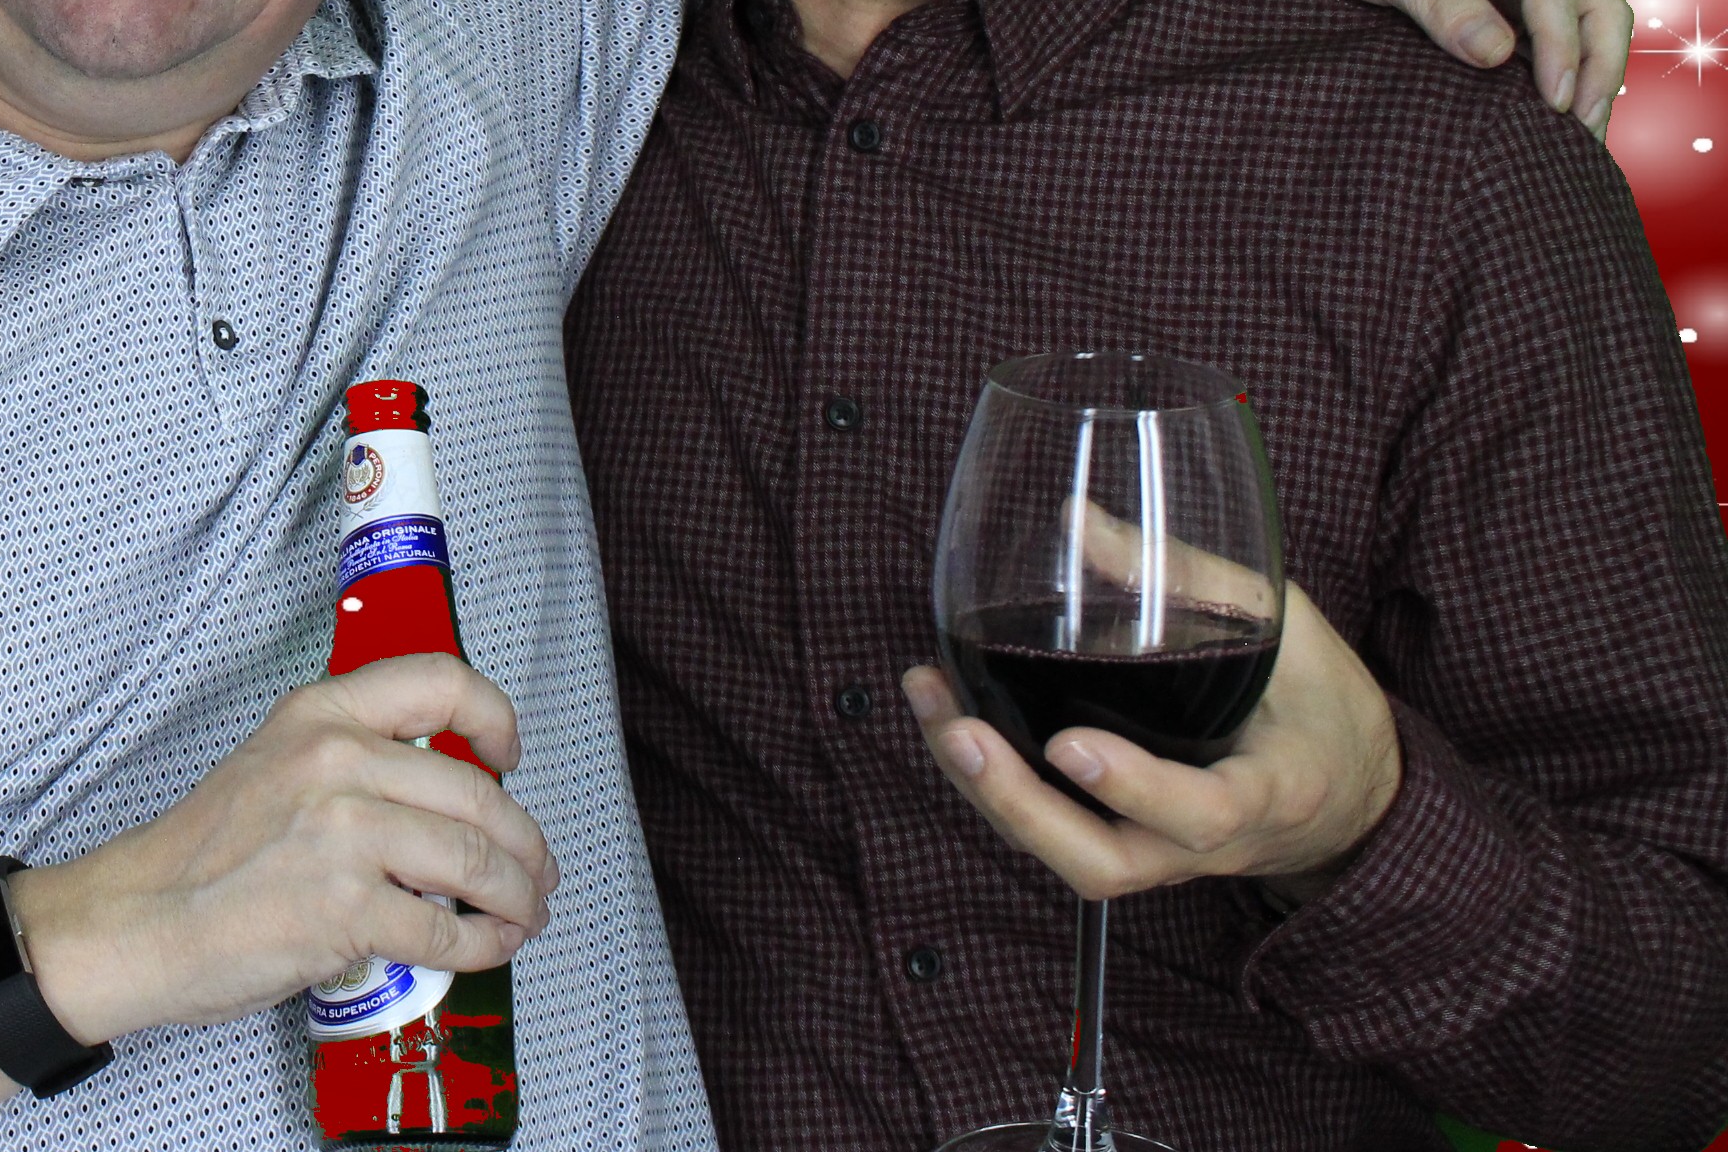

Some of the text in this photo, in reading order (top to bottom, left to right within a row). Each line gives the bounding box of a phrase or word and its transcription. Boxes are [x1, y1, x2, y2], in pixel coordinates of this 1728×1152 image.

[369, 452, 382, 489] PERONI
[372, 525, 437, 540] ORIGINALE
[384, 549, 436, 561] NATURALI
[328, 985, 400, 1018] SUPERIORE
